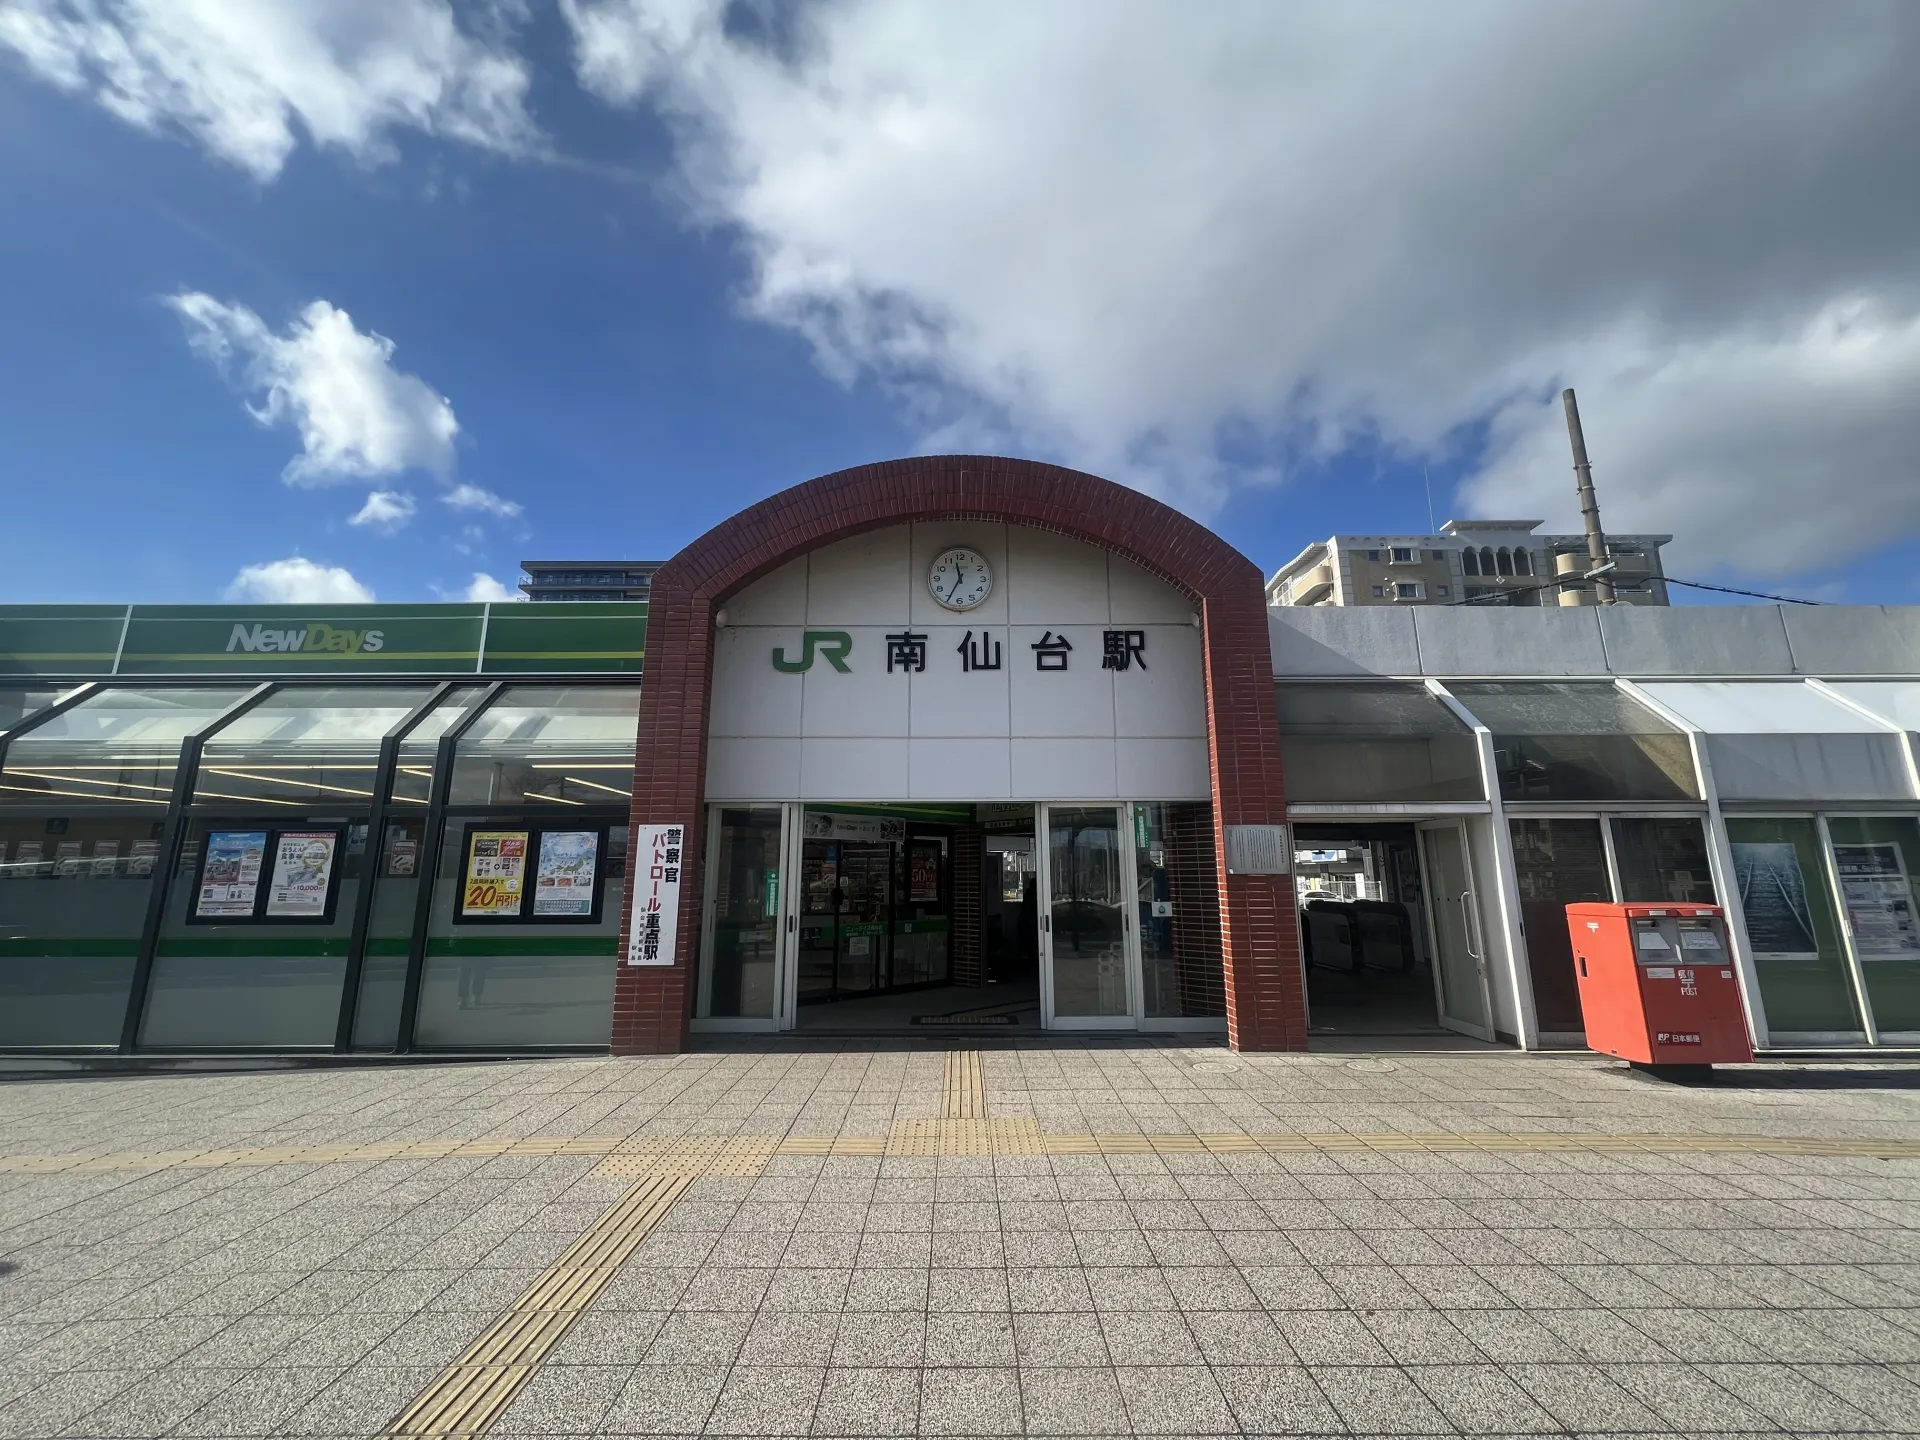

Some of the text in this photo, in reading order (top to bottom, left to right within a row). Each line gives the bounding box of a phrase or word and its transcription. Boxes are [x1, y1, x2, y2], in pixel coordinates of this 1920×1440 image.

[225, 623, 385, 654] NewDays
[772, 630, 1147, 674] JR 南仙台駅
[665, 829, 682, 883] 警察官
[643, 832, 667, 960] パトロール重点駅
[1681, 987, 1698, 996] POST
[1672, 1034, 1700, 1043] 日本郵便
